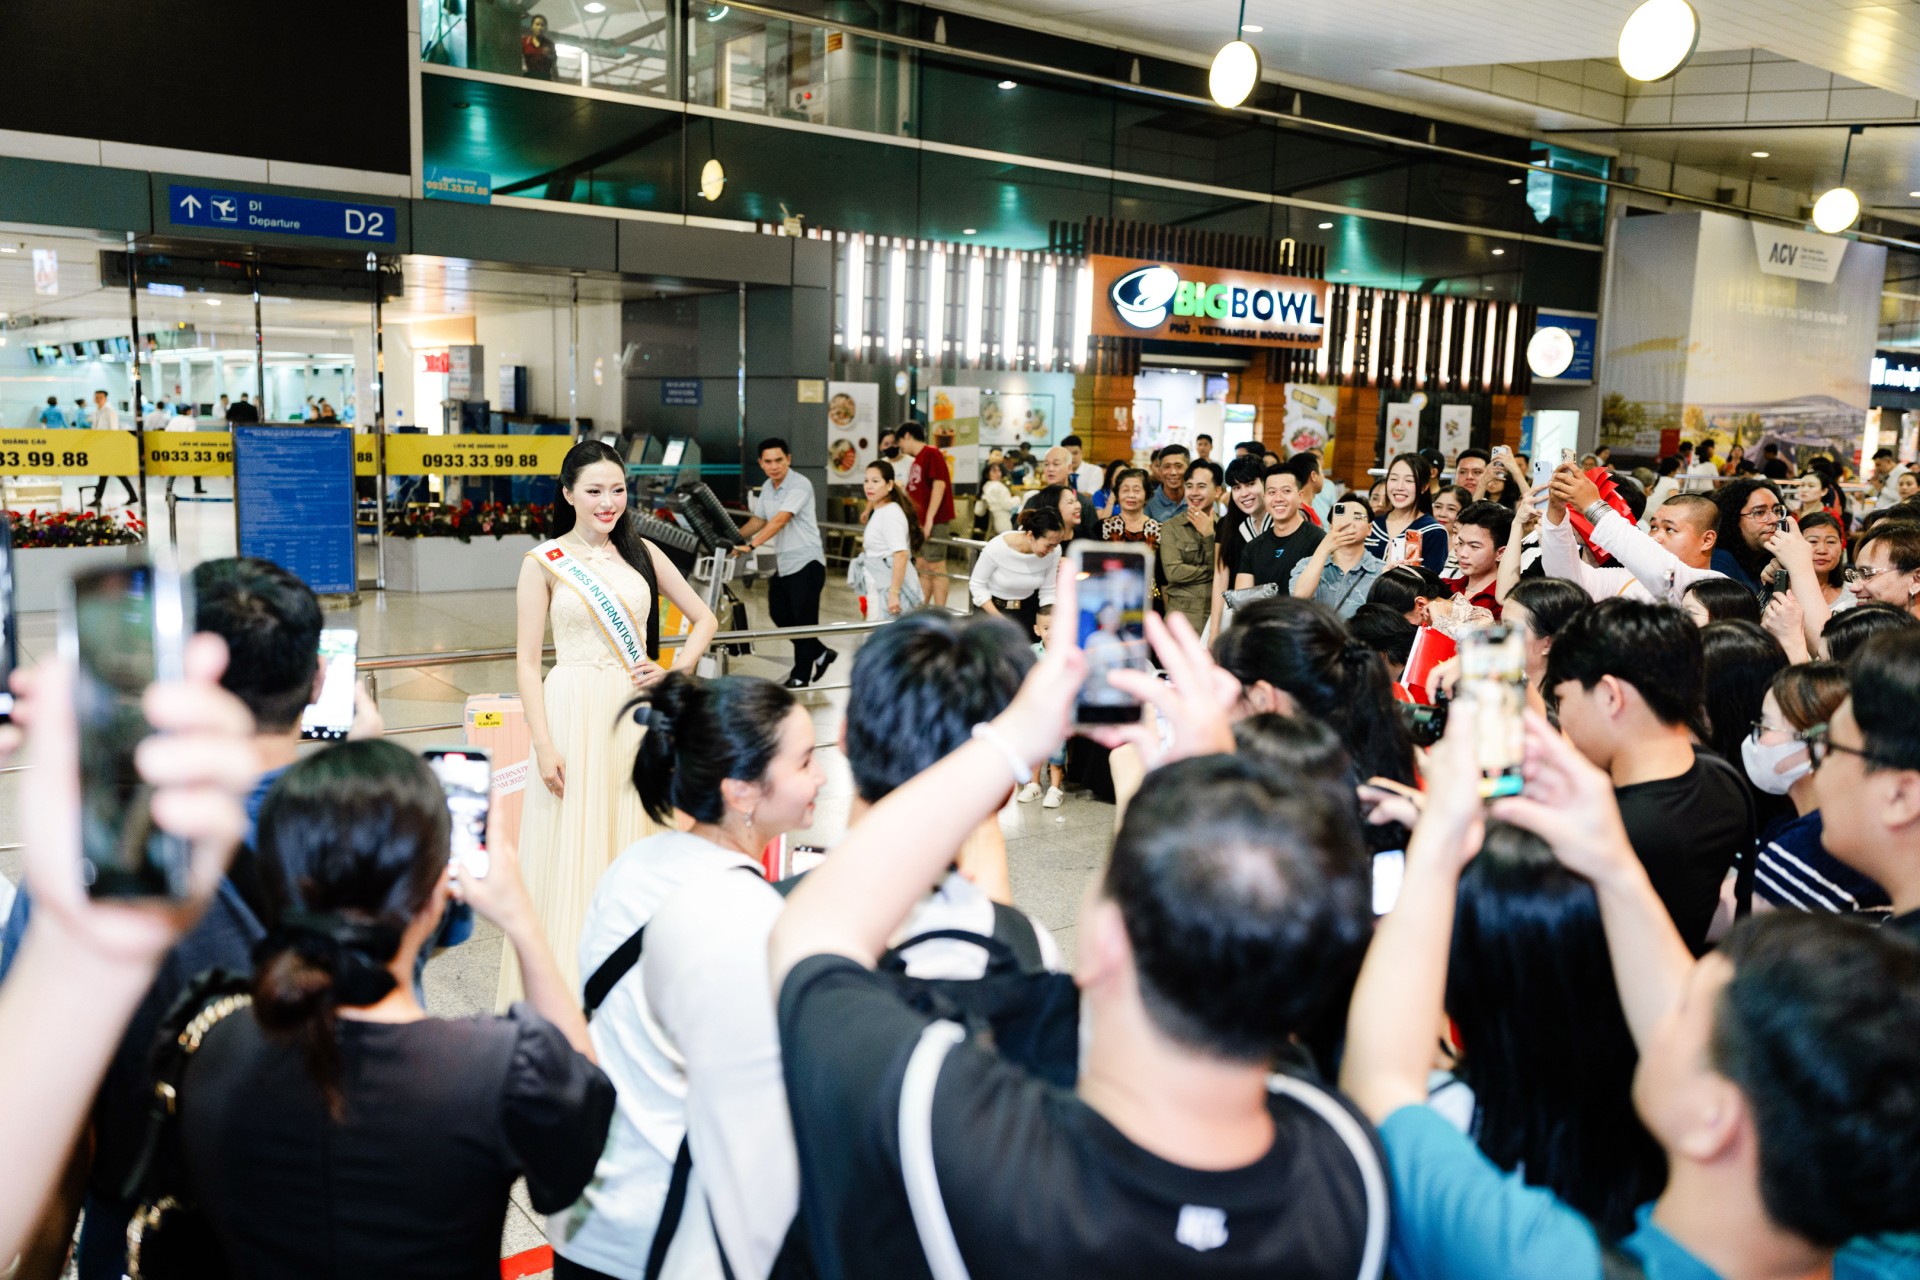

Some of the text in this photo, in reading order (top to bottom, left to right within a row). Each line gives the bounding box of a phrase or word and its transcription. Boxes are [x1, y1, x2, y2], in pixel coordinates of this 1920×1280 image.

[249, 215, 301, 229] Departure
[344, 209, 384, 237] D2
[1769, 242, 1798, 266] ACV
[1198, 325, 1257, 340] VIETNAMESE
[1260, 331, 1294, 342] NOODLE
[1298, 333, 1321, 343] SOUP
[151, 450, 233, 463] 0933.33.99
[357, 452, 373, 463] 88
[422, 454, 538, 468] 0933.33.99.88
[568, 565, 641, 663] MISS INTERNATIONAL
